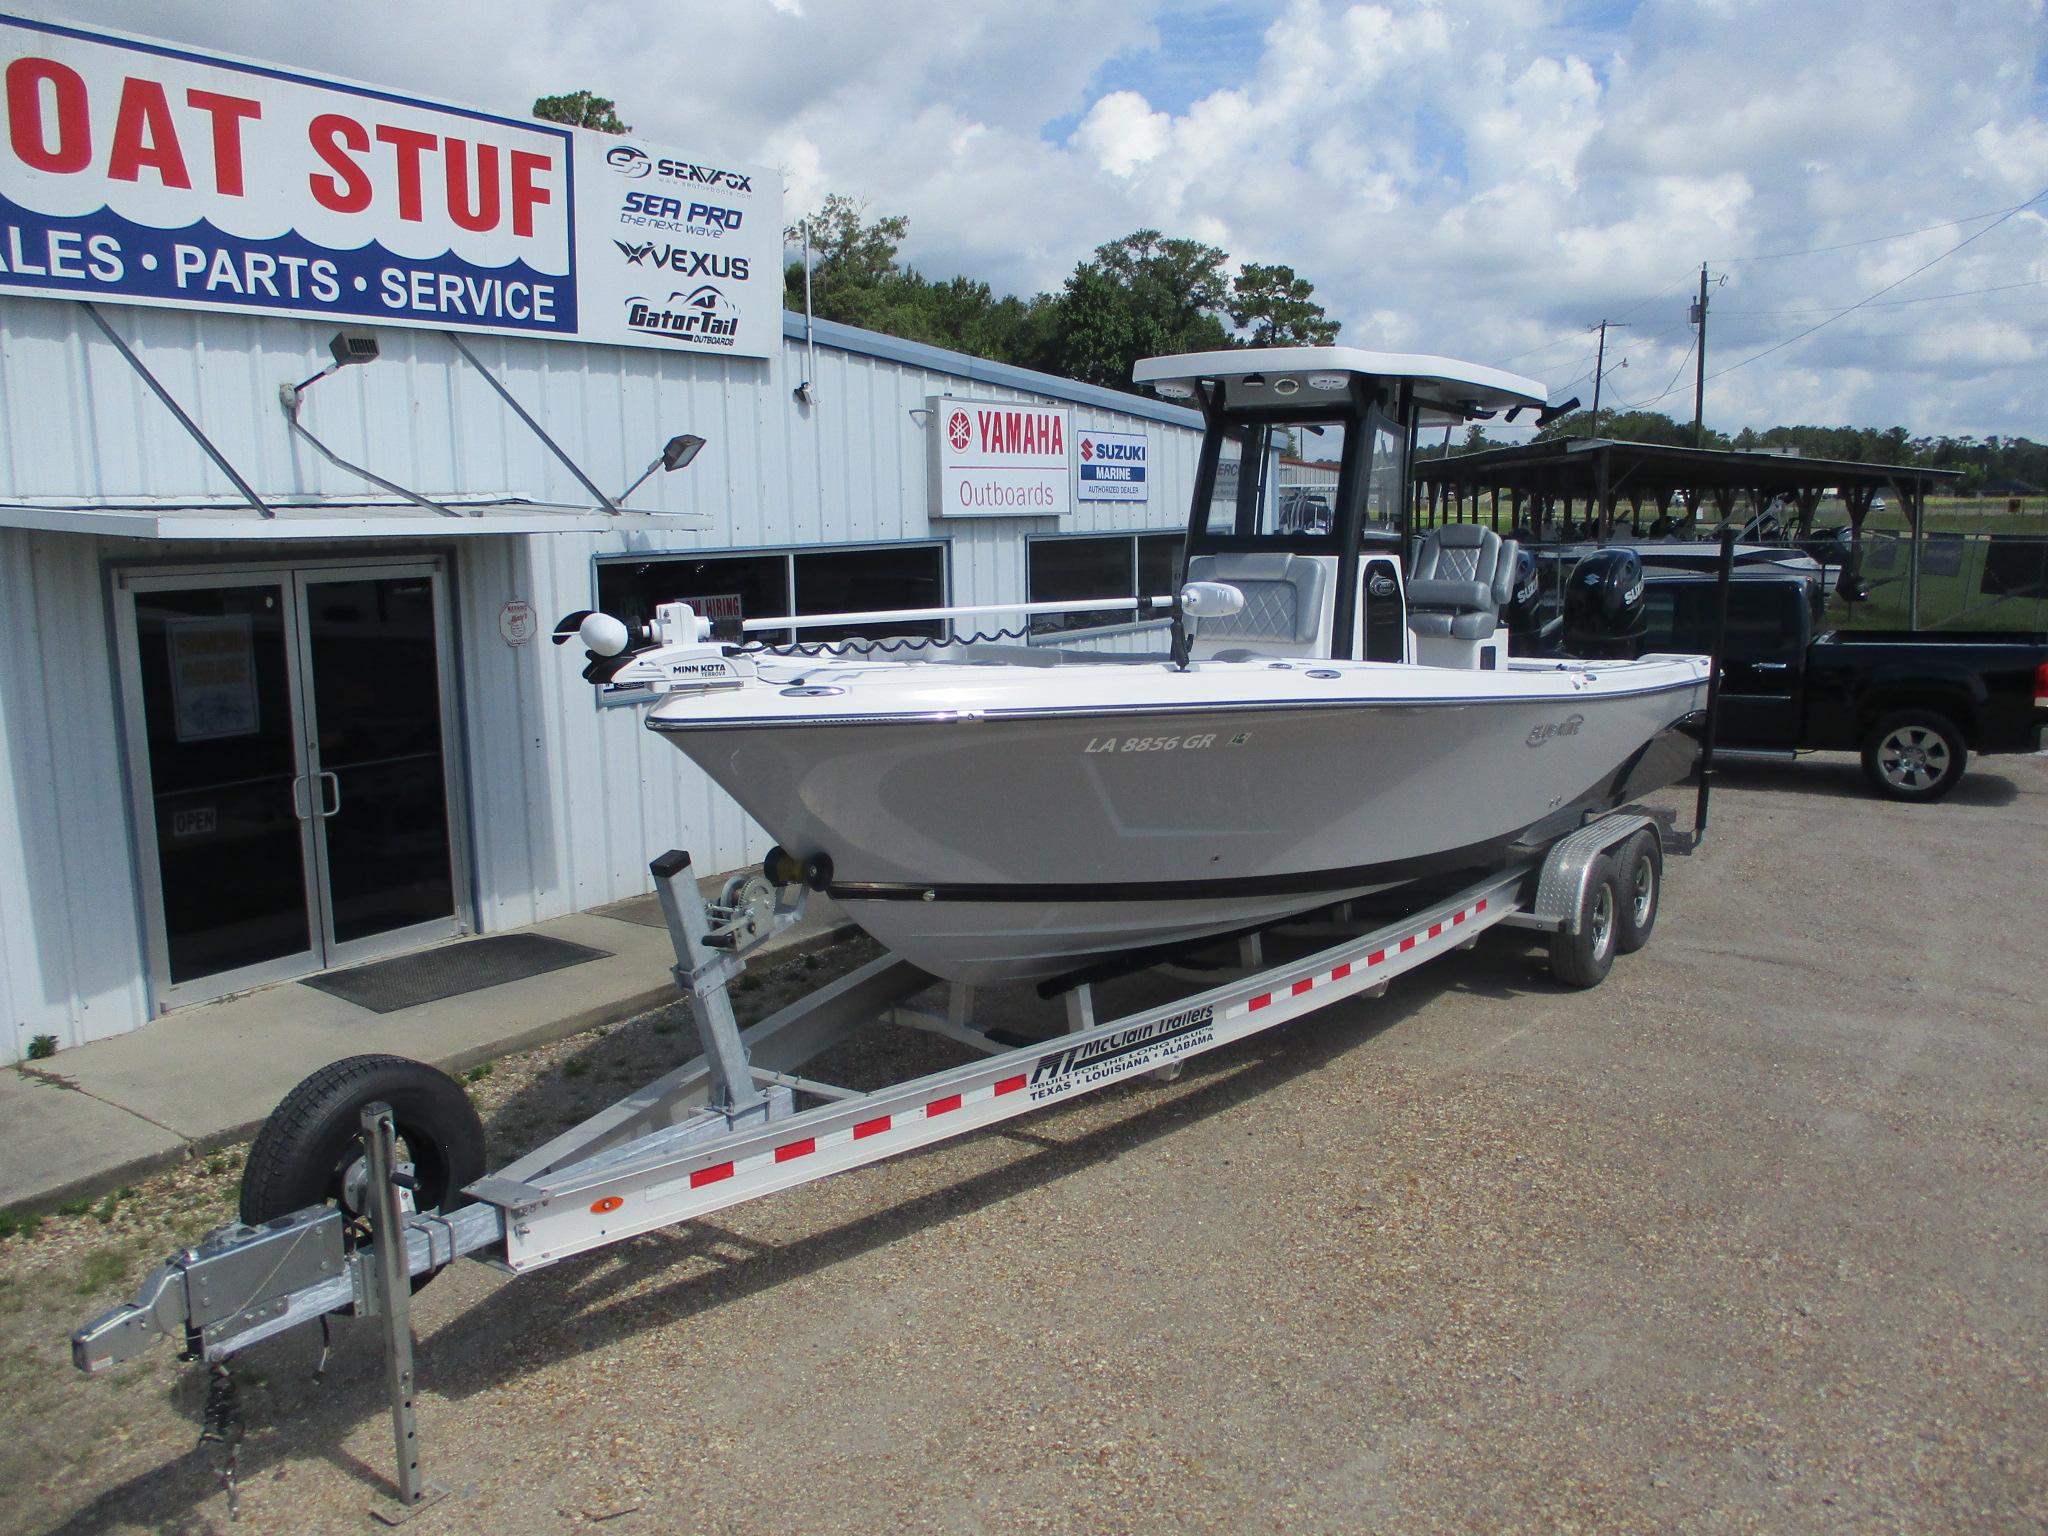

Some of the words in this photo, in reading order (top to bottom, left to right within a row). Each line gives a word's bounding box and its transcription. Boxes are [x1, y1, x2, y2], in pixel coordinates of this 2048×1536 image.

[309, 113, 552, 238] STUF
[622, 192, 682, 220] SEA
[687, 202, 743, 232] PRO
[620, 213, 646, 226] the
[648, 218, 684, 233] next
[685, 225, 723, 239] wave
[0, 226, 124, 282] LES
[174, 244, 340, 302] PARTS
[380, 267, 556, 323] SERVICE
[651, 244, 749, 281] VEXUS
[693, 334, 735, 347] OUTBOARDS
[977, 410, 1064, 455] YAMAHA
[1096, 443, 1146, 461] SUZUKI
[1096, 466, 1131, 480] MARINE
[960, 480, 1054, 507] Outboards
[1088, 486, 1119, 494] AUTHORIZED
[1120, 486, 1139, 494] DEALER
[705, 597, 740, 617] HIRING
[673, 665, 699, 674] MINN
[700, 664, 726, 672] KOTA
[1084, 737, 1117, 753] LA
[1121, 735, 1180, 752] 8856
[1182, 733, 1217, 749] GR
[177, 810, 214, 833] OPEN
[1083, 1024, 1153, 1058] McClain
[1030, 1081, 1072, 1101] TEXAS
[1086, 1055, 1150, 1083] LOUISIANA
[1162, 1033, 1214, 1057] ALABAMA
[1074, 1064, 1099, 1077] FOR
[1103, 1057, 1124, 1067] THE
[1129, 1041, 1170, 1058] LONG
